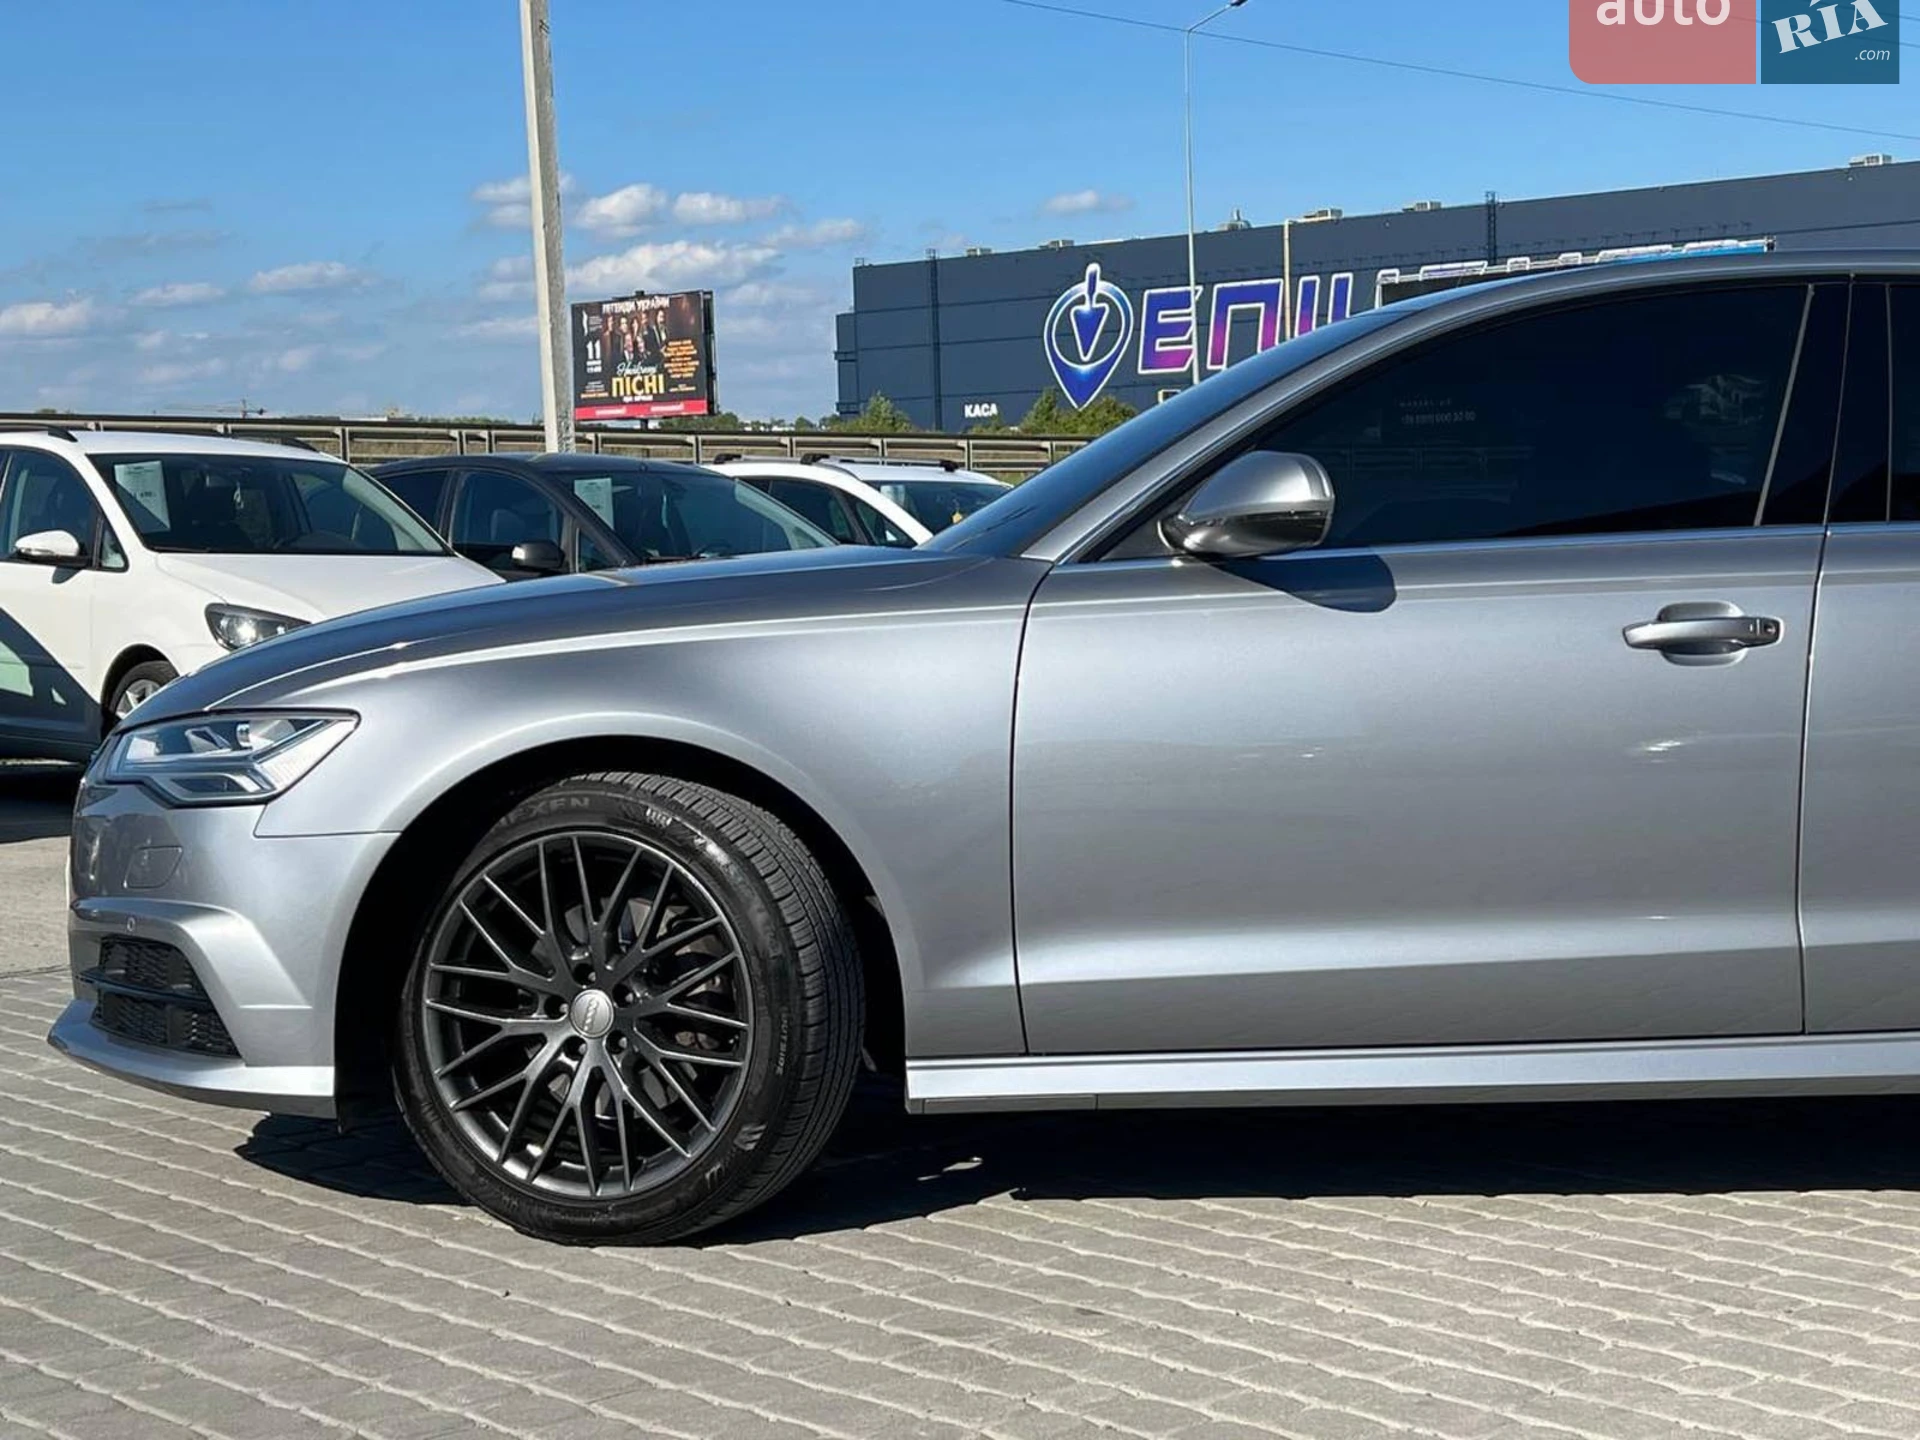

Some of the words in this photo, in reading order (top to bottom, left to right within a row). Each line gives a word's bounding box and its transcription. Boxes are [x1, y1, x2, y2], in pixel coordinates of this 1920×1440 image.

[586, 339, 601, 360] 11
[611, 375, 665, 397] ПІСНІ
[964, 403, 998, 418] КАСА
